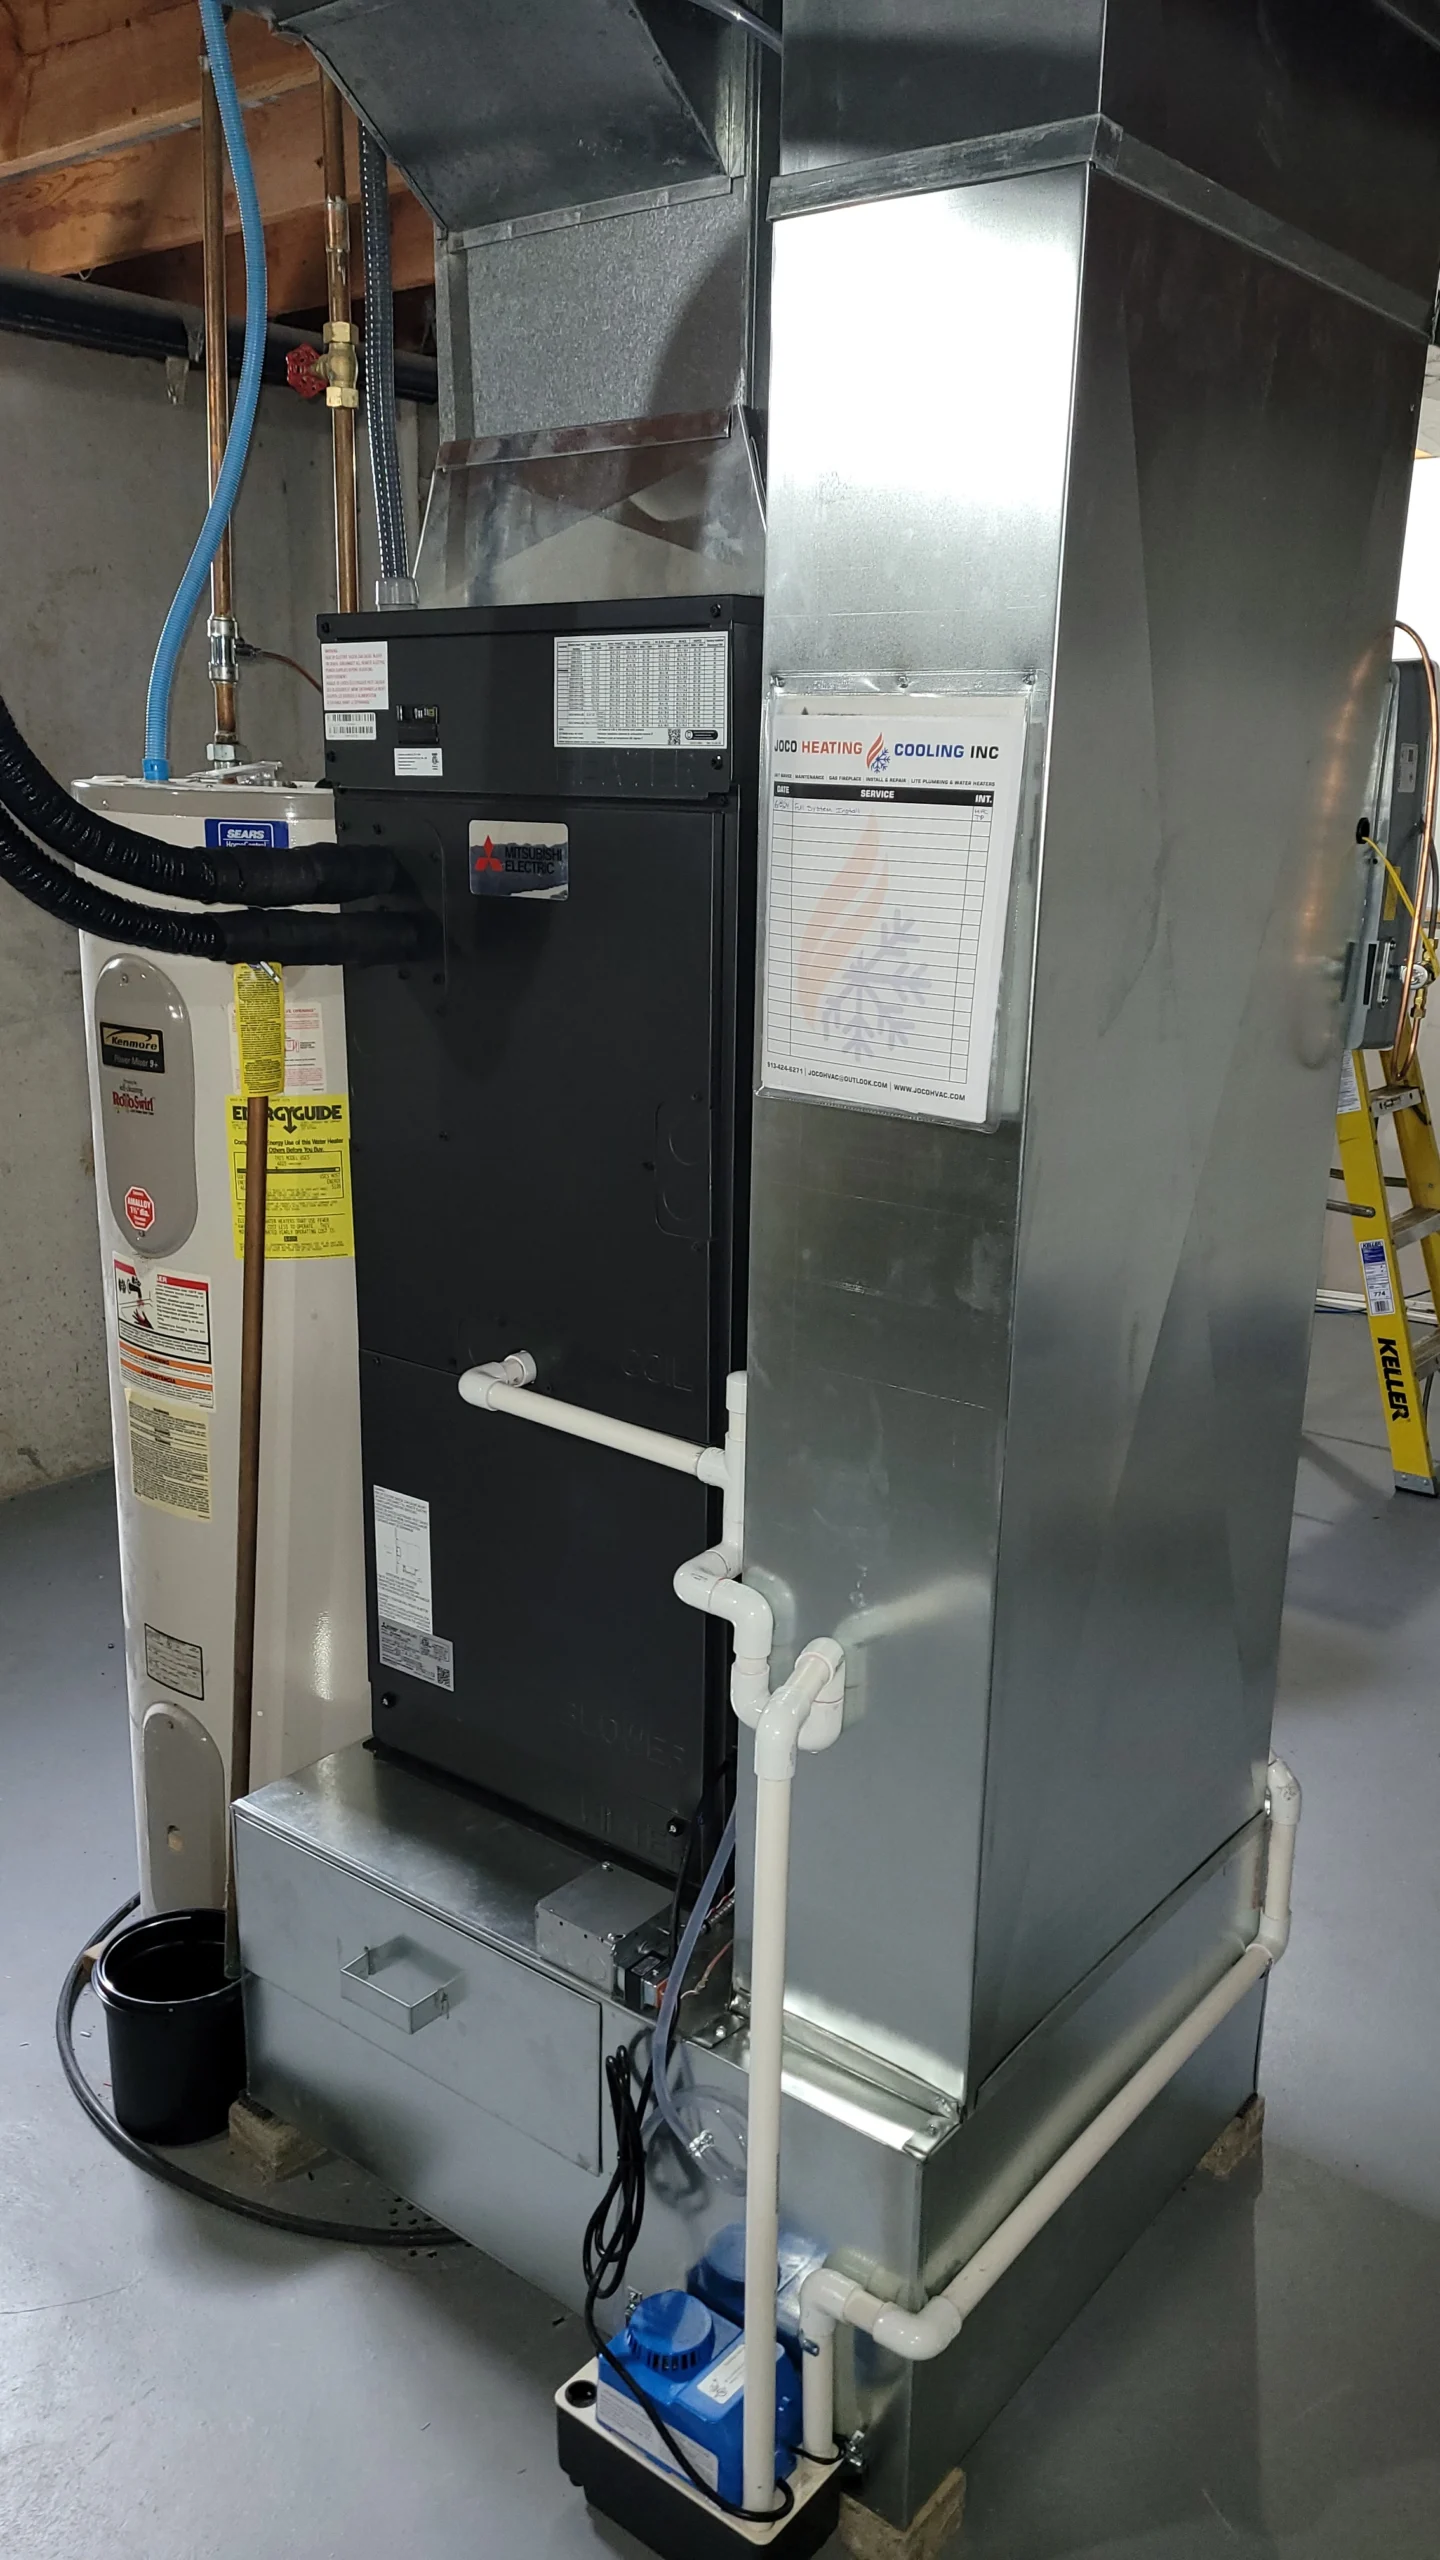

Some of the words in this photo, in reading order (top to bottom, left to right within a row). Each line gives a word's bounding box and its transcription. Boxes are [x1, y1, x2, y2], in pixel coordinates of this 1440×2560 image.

[774, 739, 797, 753] JOCO
[801, 740, 863, 755] HEATING
[894, 743, 964, 758] COOLING
[970, 745, 999, 760] INC
[776, 785, 790, 794] DATE
[860, 788, 895, 799] SERVICE
[975, 794, 993, 804] INT.
[226, 828, 265, 840] SEARS
[505, 846, 563, 862] MITSUBISHI
[505, 861, 555, 875] ELECTRIC
[111, 1036, 158, 1050] Kenmore
[894, 1084, 966, 1101] WWW.JOCOHVAC.COM
[232, 1104, 342, 1122] ERGYGUIDE
[1377, 1337, 1410, 1422] KELLER
